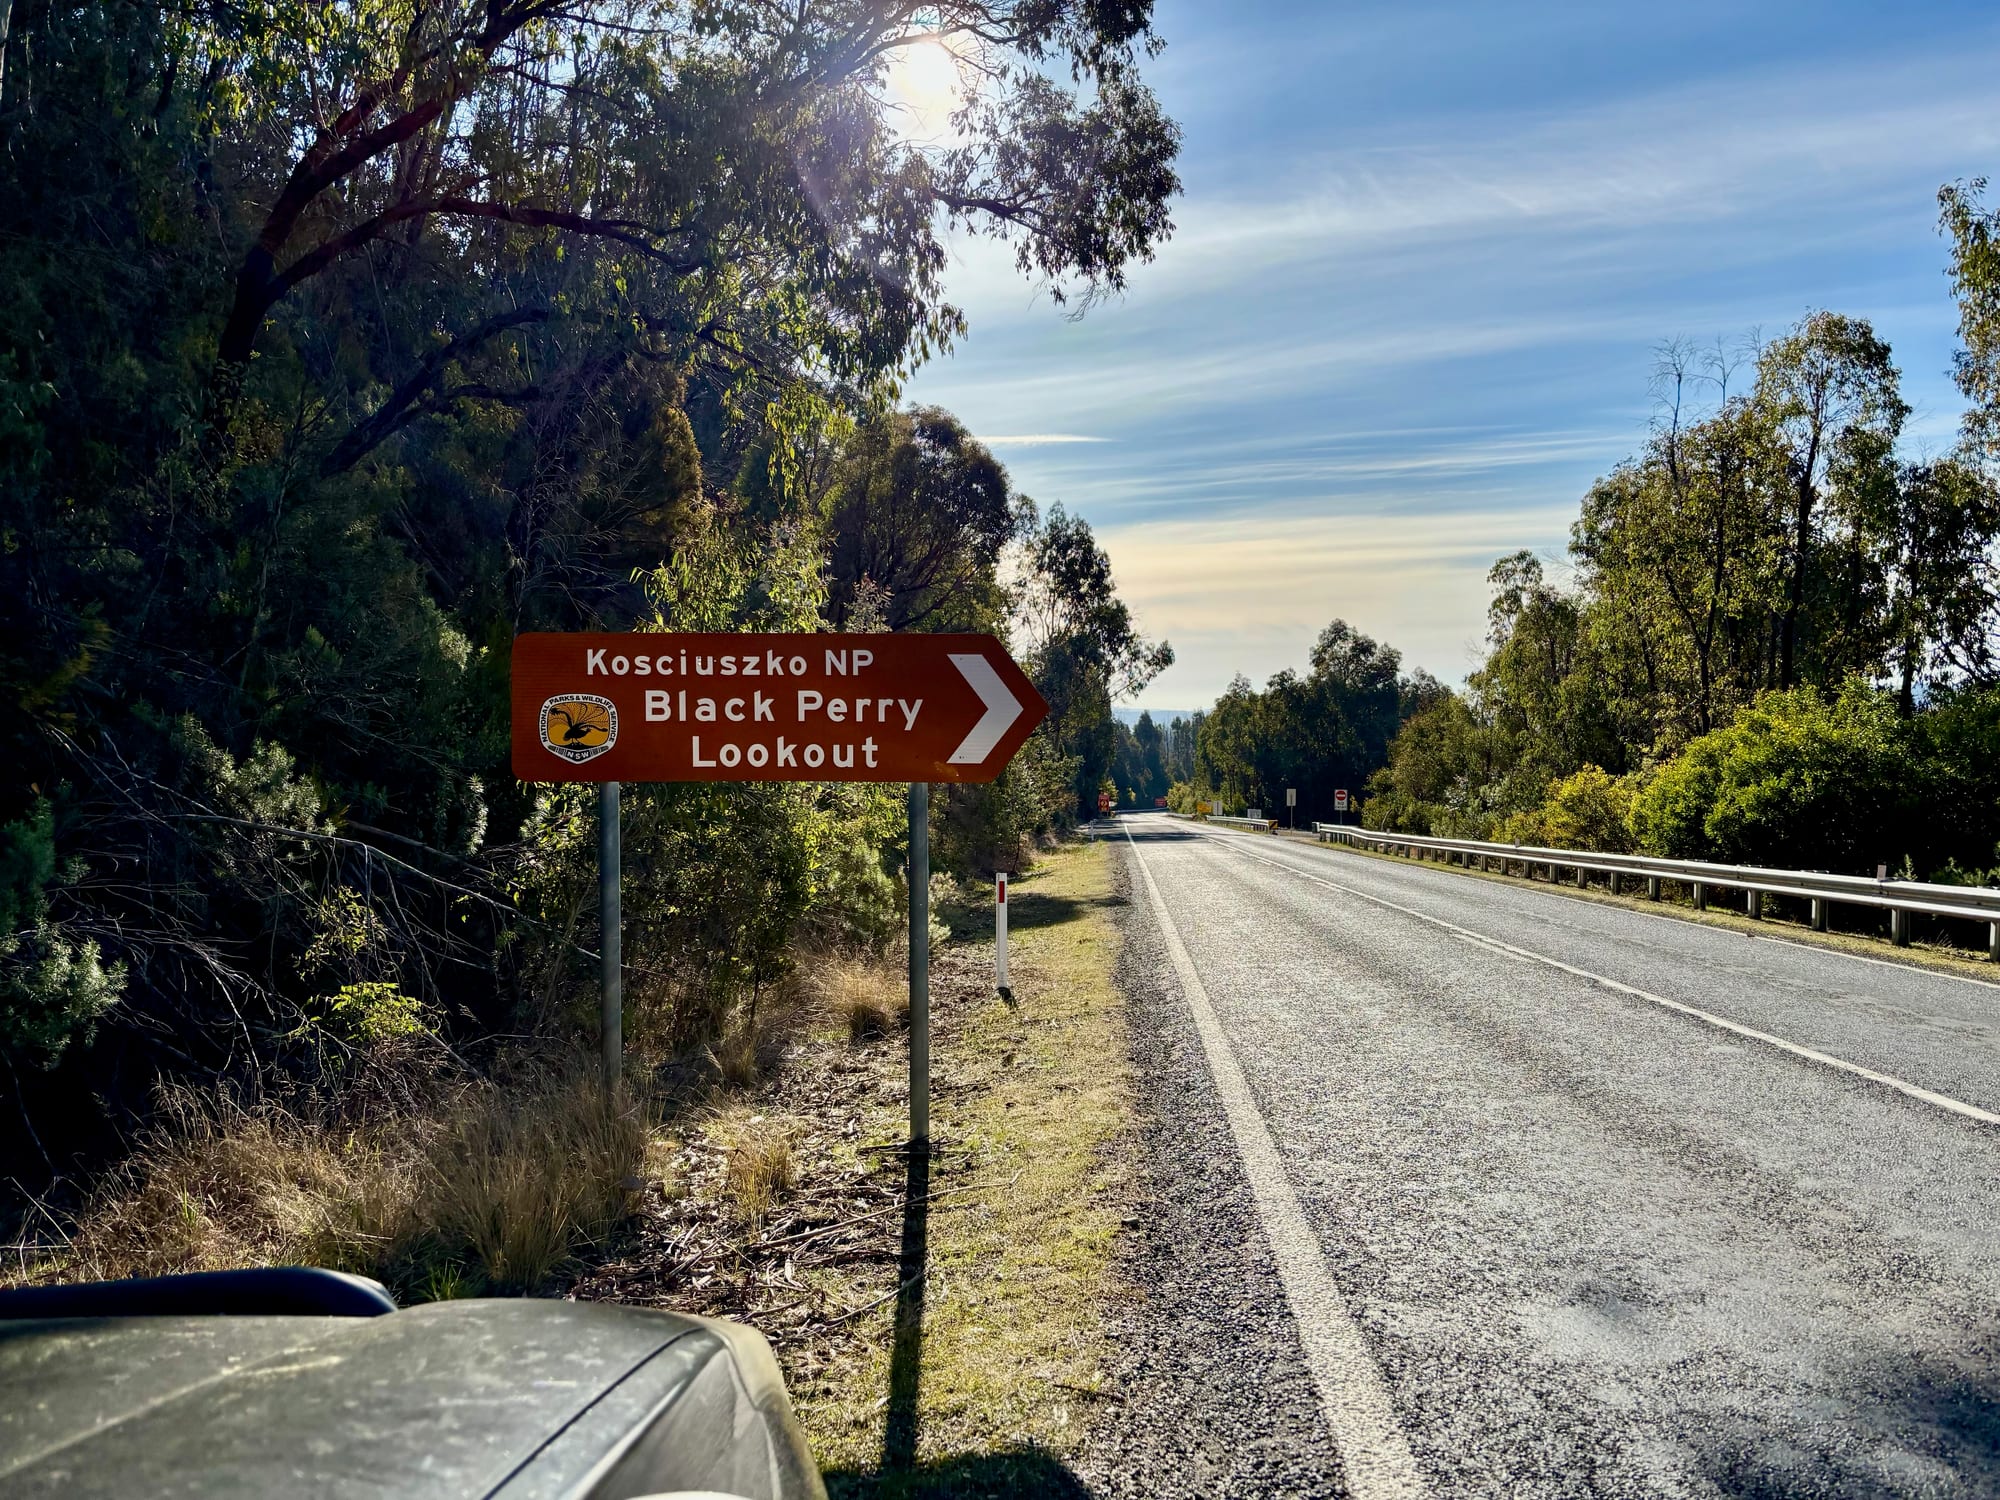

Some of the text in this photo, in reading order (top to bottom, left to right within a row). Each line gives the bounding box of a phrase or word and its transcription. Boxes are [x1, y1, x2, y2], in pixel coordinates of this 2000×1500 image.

[587, 649, 874, 676] Kosciuszko NP
[540, 704, 550, 743] NATIONAL
[549, 695, 575, 705] PARKS
[581, 695, 614, 710] WILDLIFE
[645, 689, 923, 731] Black Perry
[692, 736, 879, 768] Lookout
